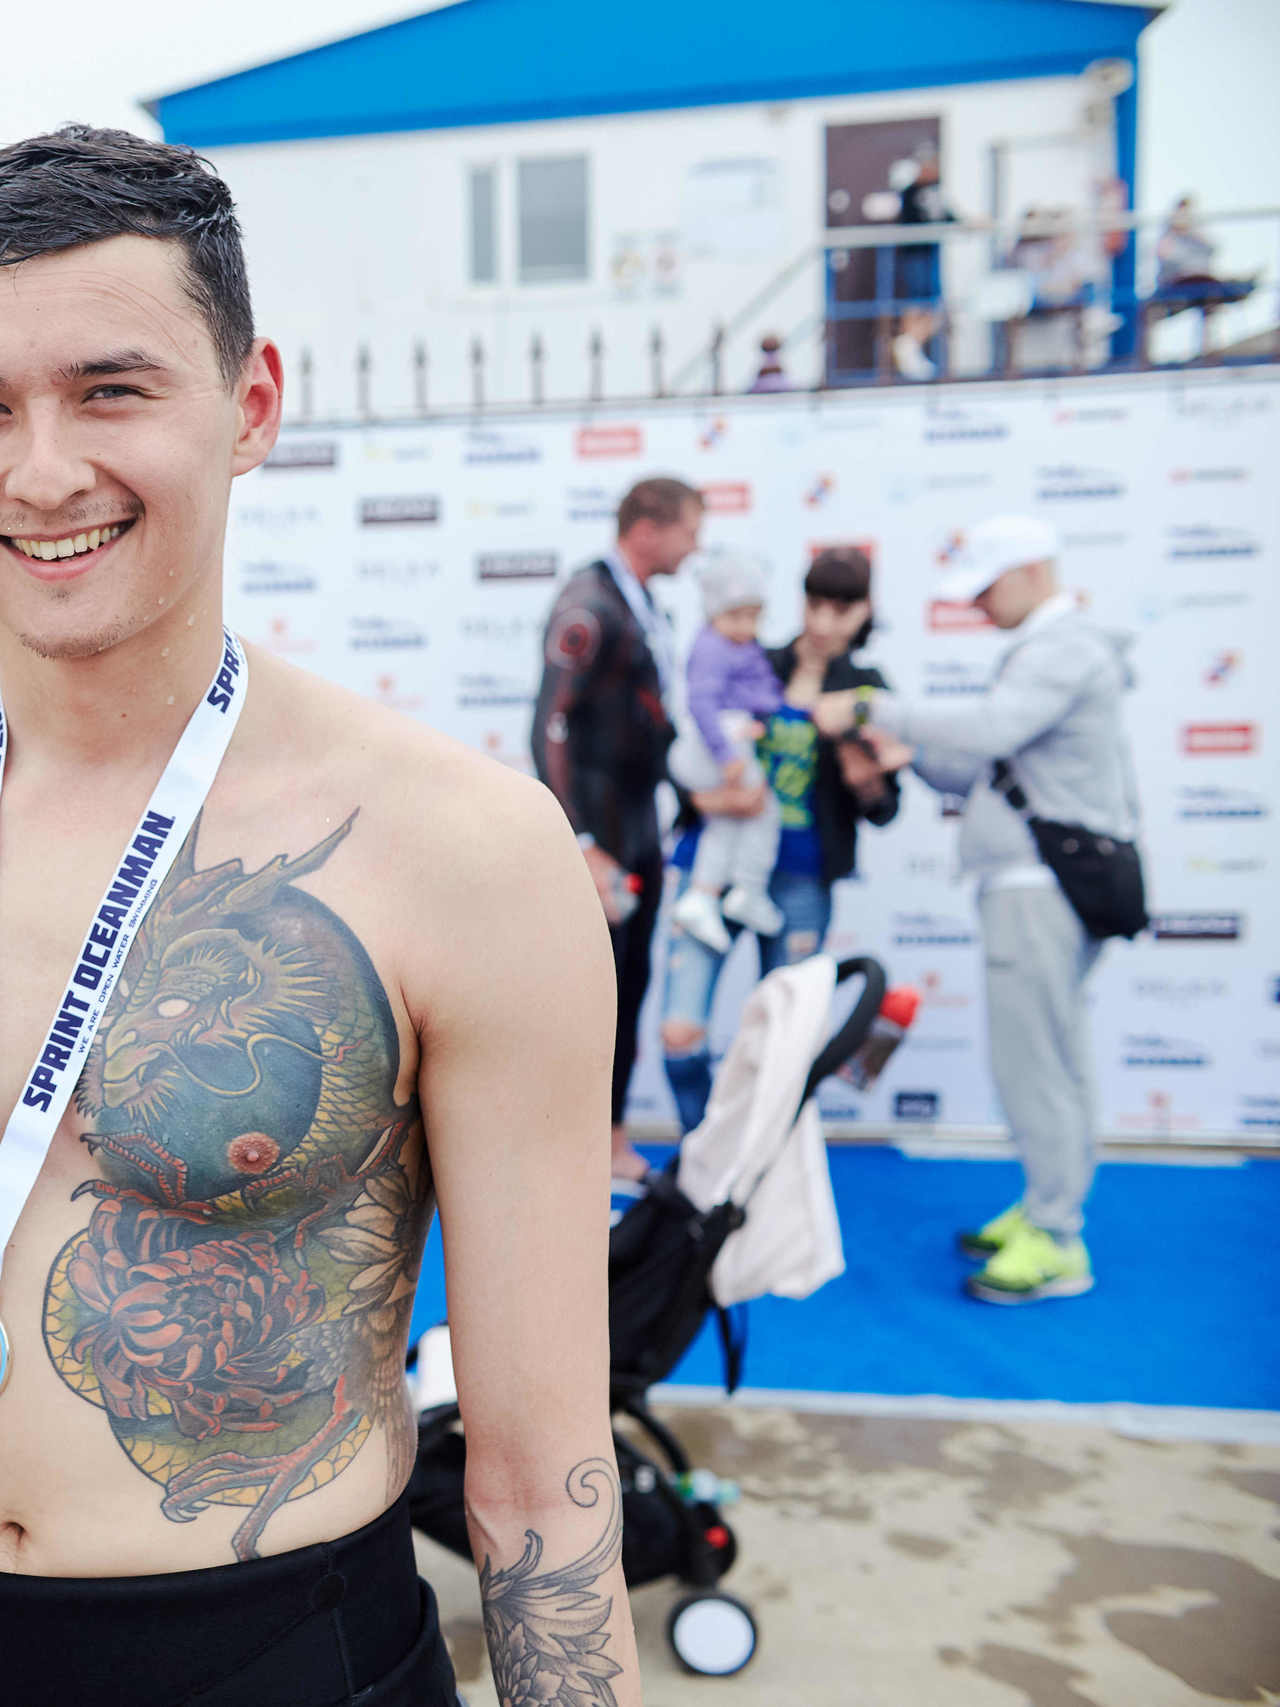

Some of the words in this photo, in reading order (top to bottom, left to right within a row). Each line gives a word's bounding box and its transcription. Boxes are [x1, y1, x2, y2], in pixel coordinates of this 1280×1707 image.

[22, 990, 91, 1112] SPRINT
[72, 810, 174, 990] OCEANMAN
[78, 1037, 90, 1053] WE
[87, 1009, 100, 1032] ARE
[98, 973, 114, 1003] OPEN
[111, 934, 130, 968] WATER
[128, 878, 158, 928] SWIMMING
